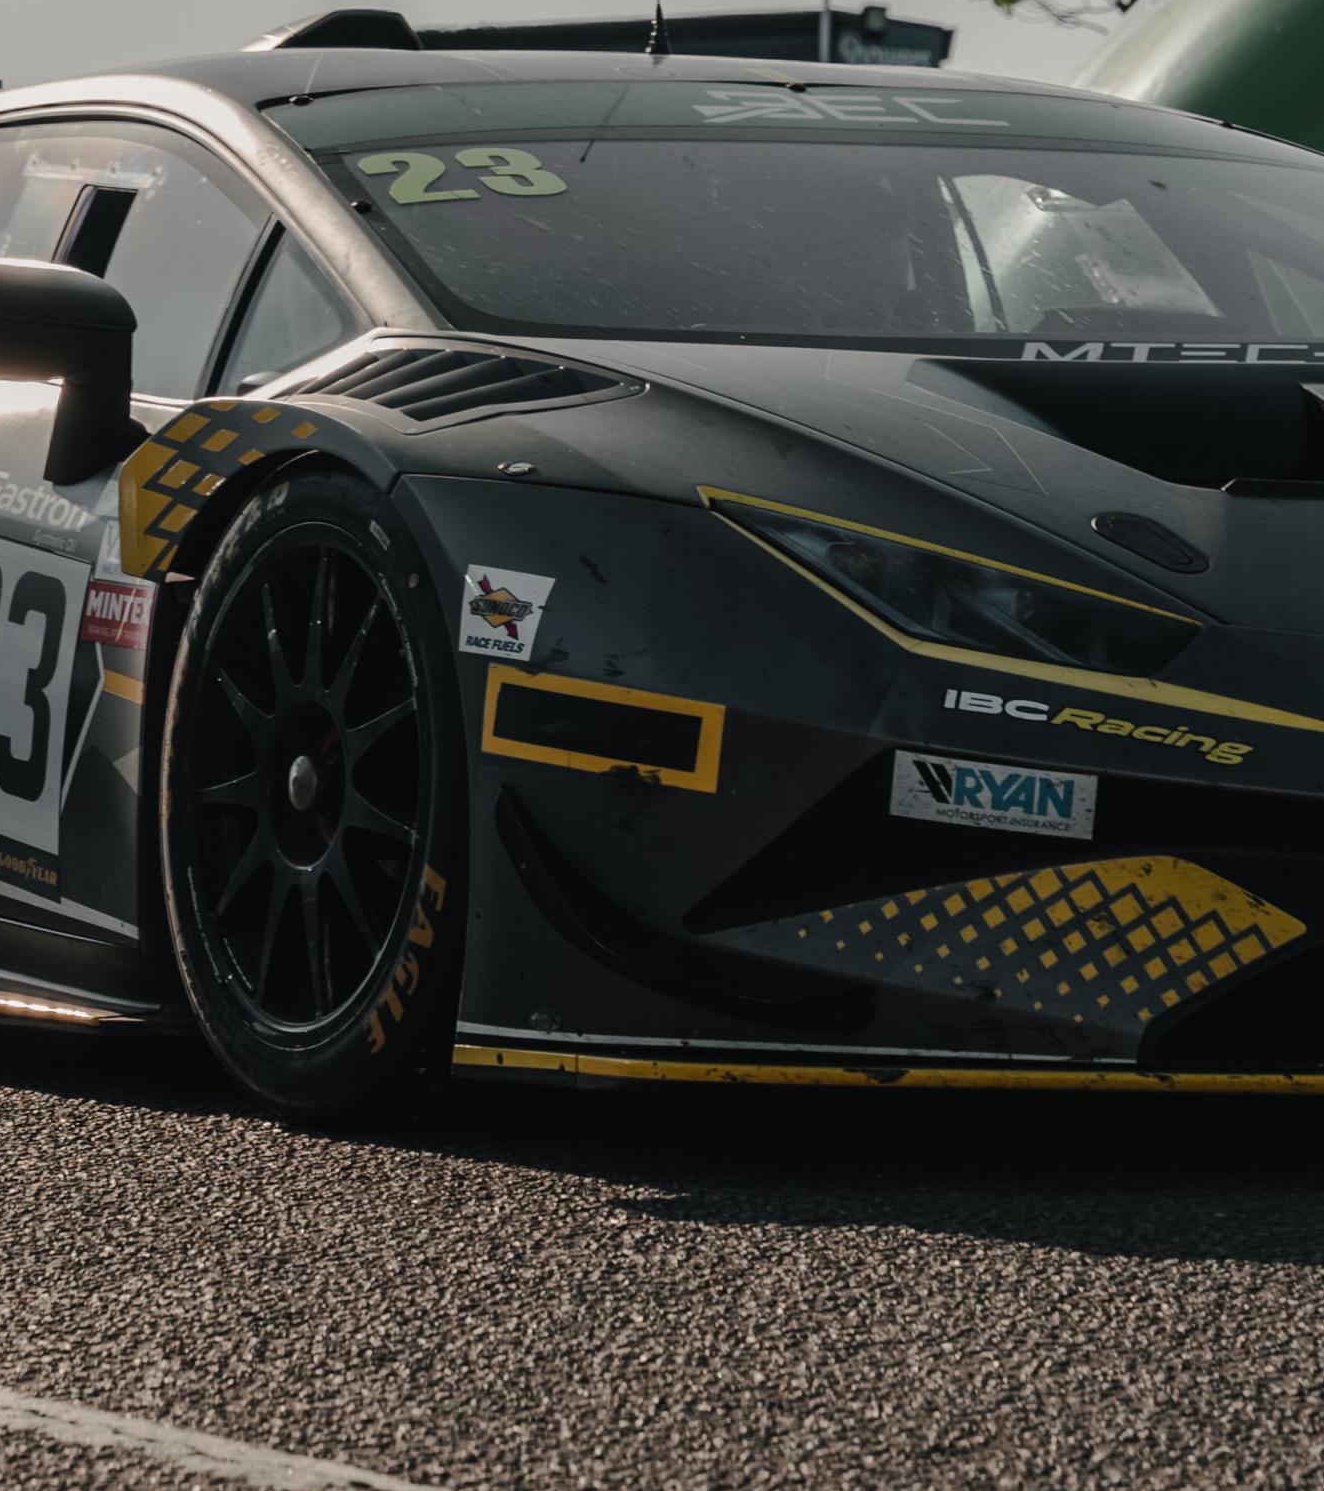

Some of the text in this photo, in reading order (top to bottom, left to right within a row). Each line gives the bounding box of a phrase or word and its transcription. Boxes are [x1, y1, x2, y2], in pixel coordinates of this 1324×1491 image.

[358, 148, 567, 205] 23
[85, 589, 153, 626] MINTEX
[466, 636, 525, 653] RACE FUELS
[943, 688, 1253, 766] IBC Racing
[936, 808, 1008, 825] MOTORSPORT
[953, 766, 1074, 818] RYAN
[363, 863, 448, 1055] EAGLE
